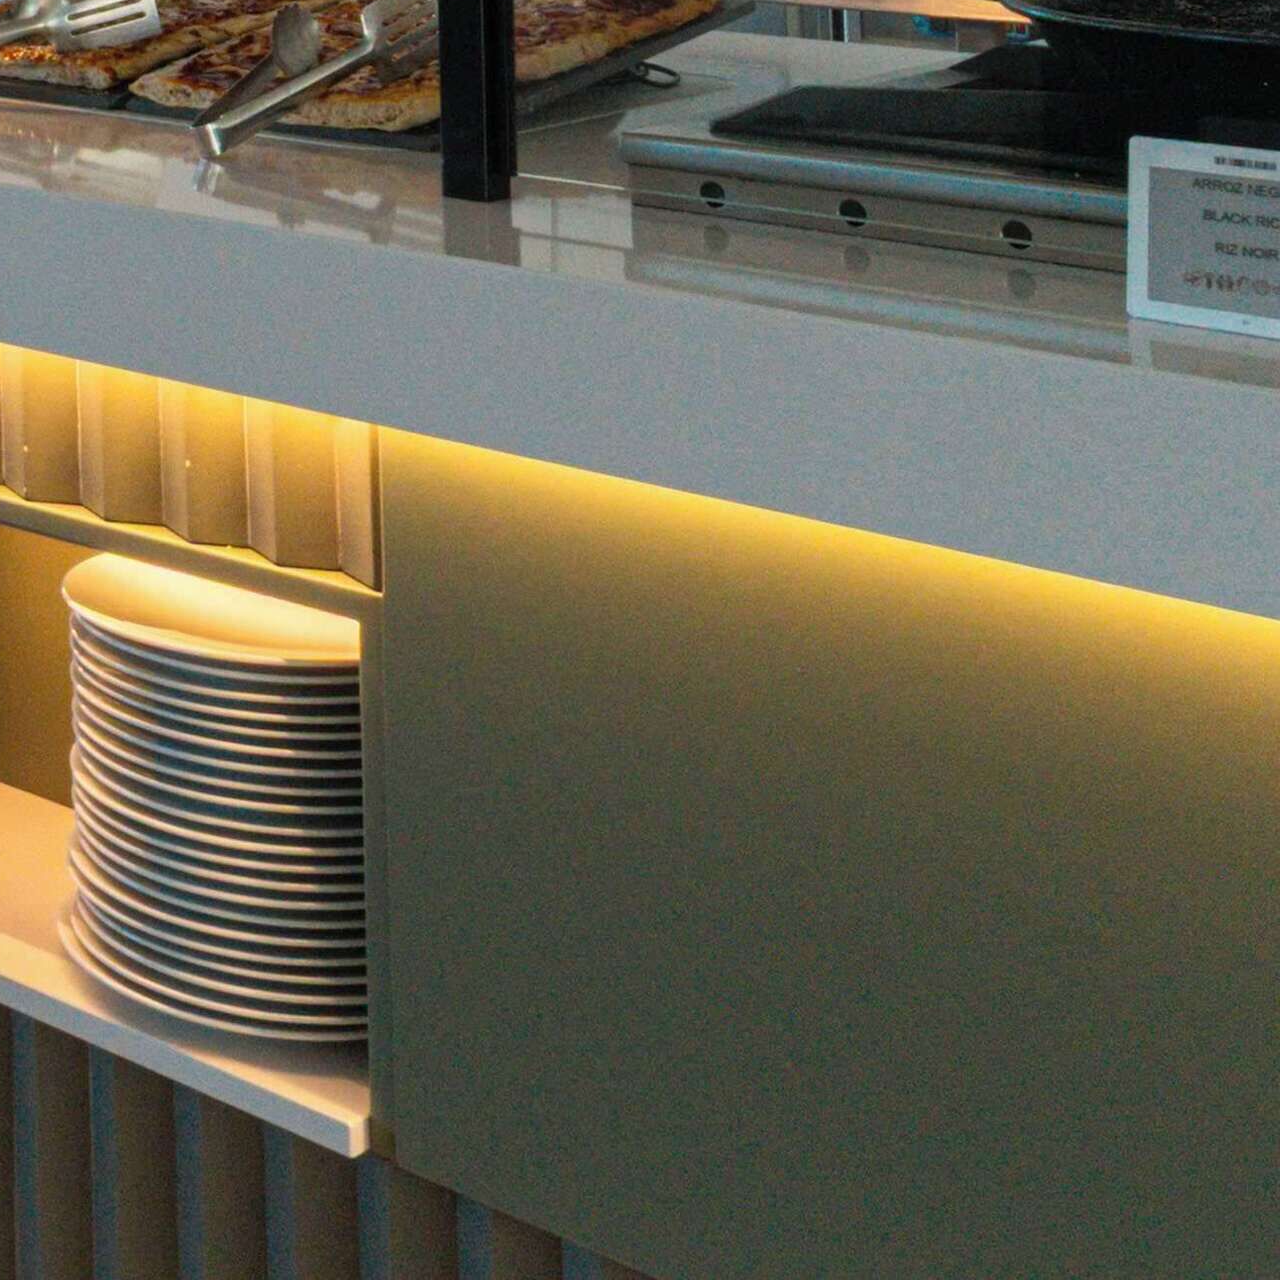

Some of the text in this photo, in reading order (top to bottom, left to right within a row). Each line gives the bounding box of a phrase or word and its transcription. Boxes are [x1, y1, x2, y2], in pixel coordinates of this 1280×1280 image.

[1192, 178, 1243, 194] ARROZ
[1203, 209, 1252, 225] BLACK
[1215, 242, 1279, 261] RIZ NOIR
